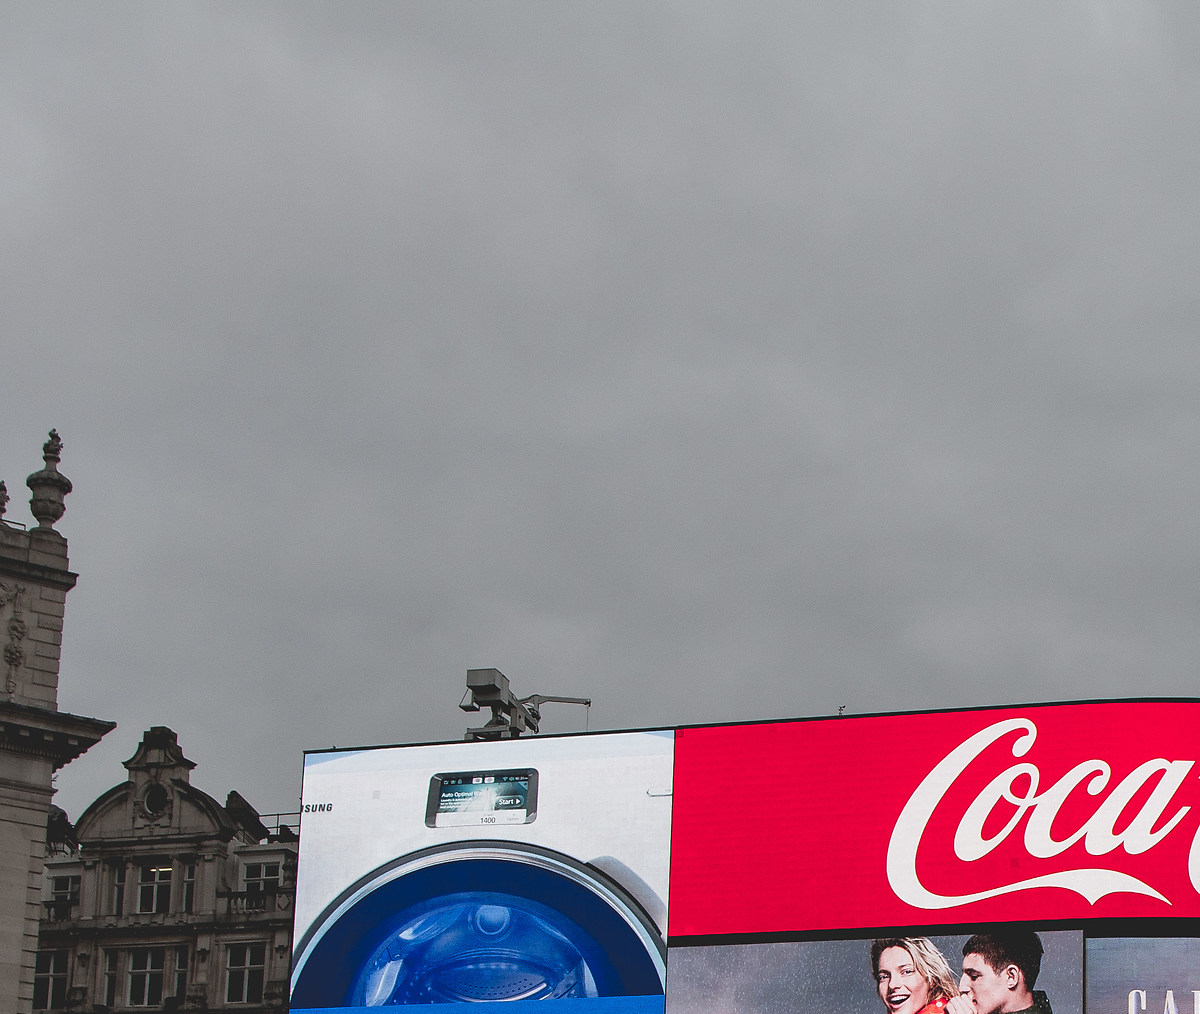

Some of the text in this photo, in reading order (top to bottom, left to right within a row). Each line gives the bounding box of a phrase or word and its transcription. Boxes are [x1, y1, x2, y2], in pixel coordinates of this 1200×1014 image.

[498, 798, 515, 806] Start
[300, 803, 333, 813] SUNG
[480, 816, 497, 824] 1400
